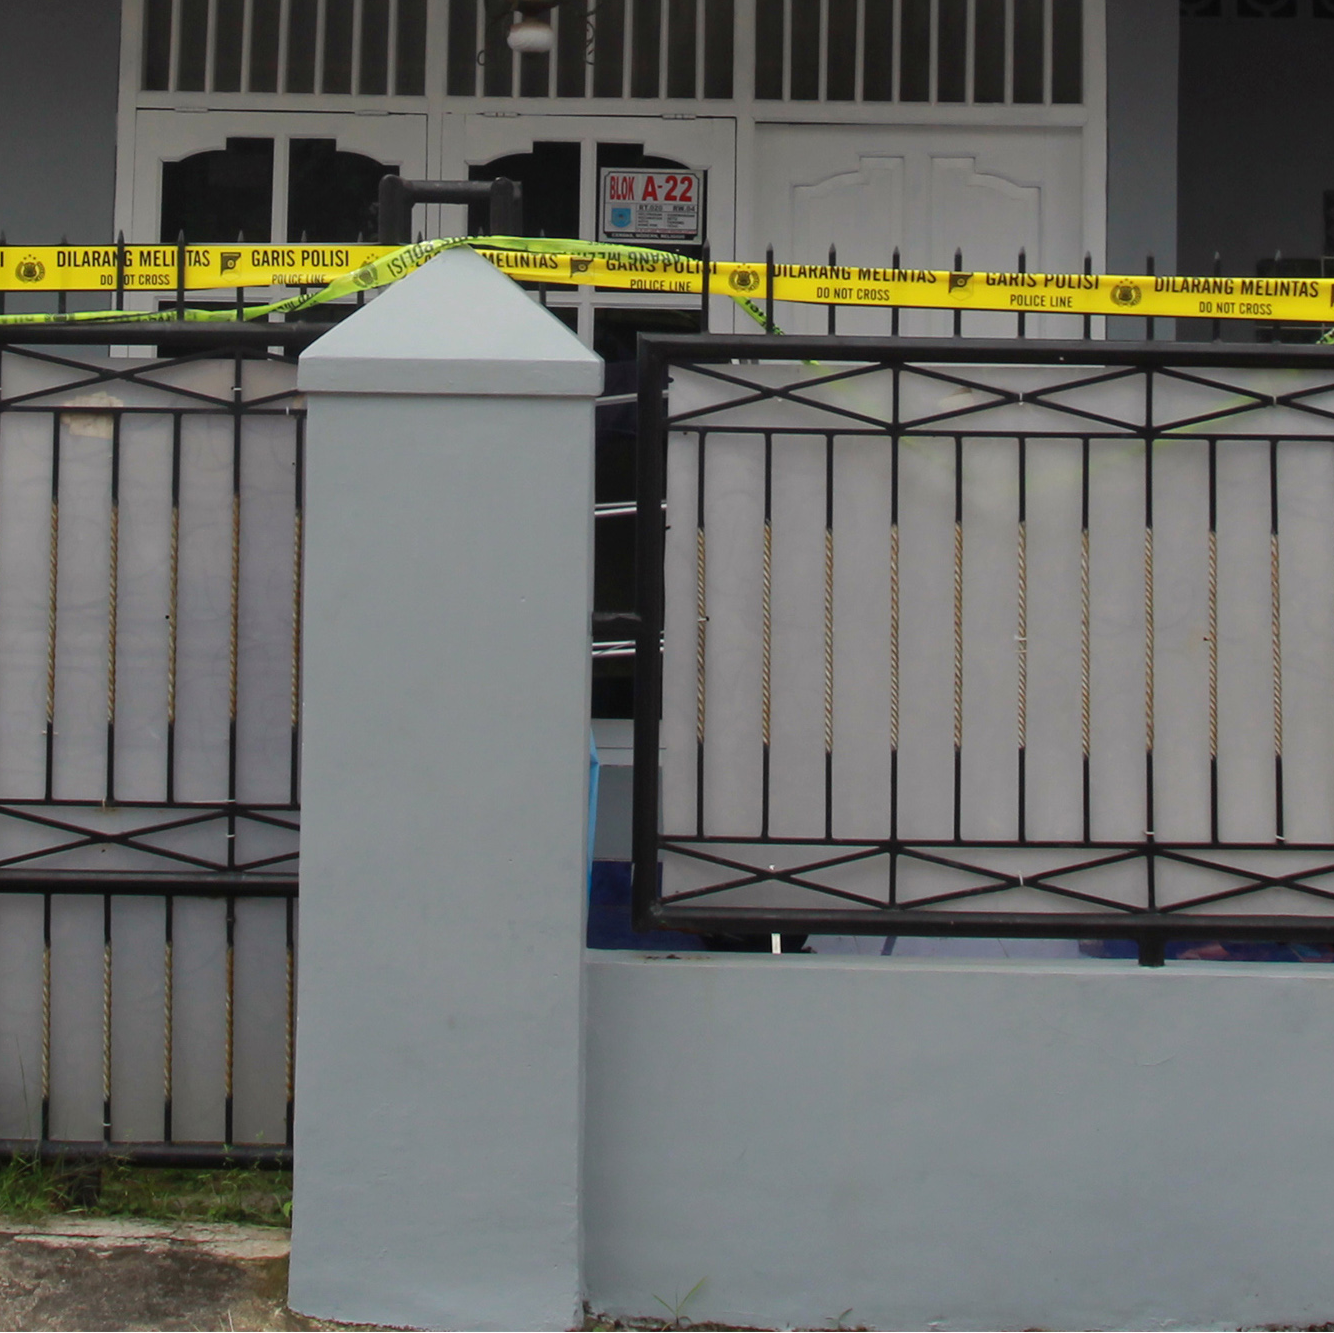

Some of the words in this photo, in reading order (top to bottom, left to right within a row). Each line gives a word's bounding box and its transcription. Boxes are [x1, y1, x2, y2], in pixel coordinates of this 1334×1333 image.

[609, 175, 635, 201] BLOK
[641, 175, 693, 202] A-22
[57, 250, 133, 267] DILARANG
[139, 250, 211, 266] MELITAS
[251, 250, 296, 267] GARIS
[301, 250, 350, 266] POLISI
[387, 243, 434, 278] POLISI
[606, 258, 657, 273] GARIS
[100, 274, 114, 286] DO
[122, 274, 139, 286] OT
[138, 274, 171, 286] CROSS
[271, 273, 303, 285] POLICE
[306, 273, 326, 285] LINE
[772, 263, 852, 281] DILARANG
[858, 267, 937, 284] MELINTAS
[986, 272, 1037, 288] GARIS
[1044, 274, 1100, 290] POLISI
[630, 278, 666, 291] POLICE
[669, 280, 692, 292] LINE
[1153, 276, 1236, 295] DILARANG
[1241, 278, 1320, 298] MELINTAS
[816, 286, 830, 299] DO
[834, 287, 853, 300] NOT
[856, 288, 890, 301] CROSS
[1010, 294, 1046, 307] POLICE
[1049, 296, 1073, 308] LINE
[1198, 300, 1212, 314] DO
[1215, 301, 1236, 315] NOT
[1239, 302, 1273, 315] CROSS
